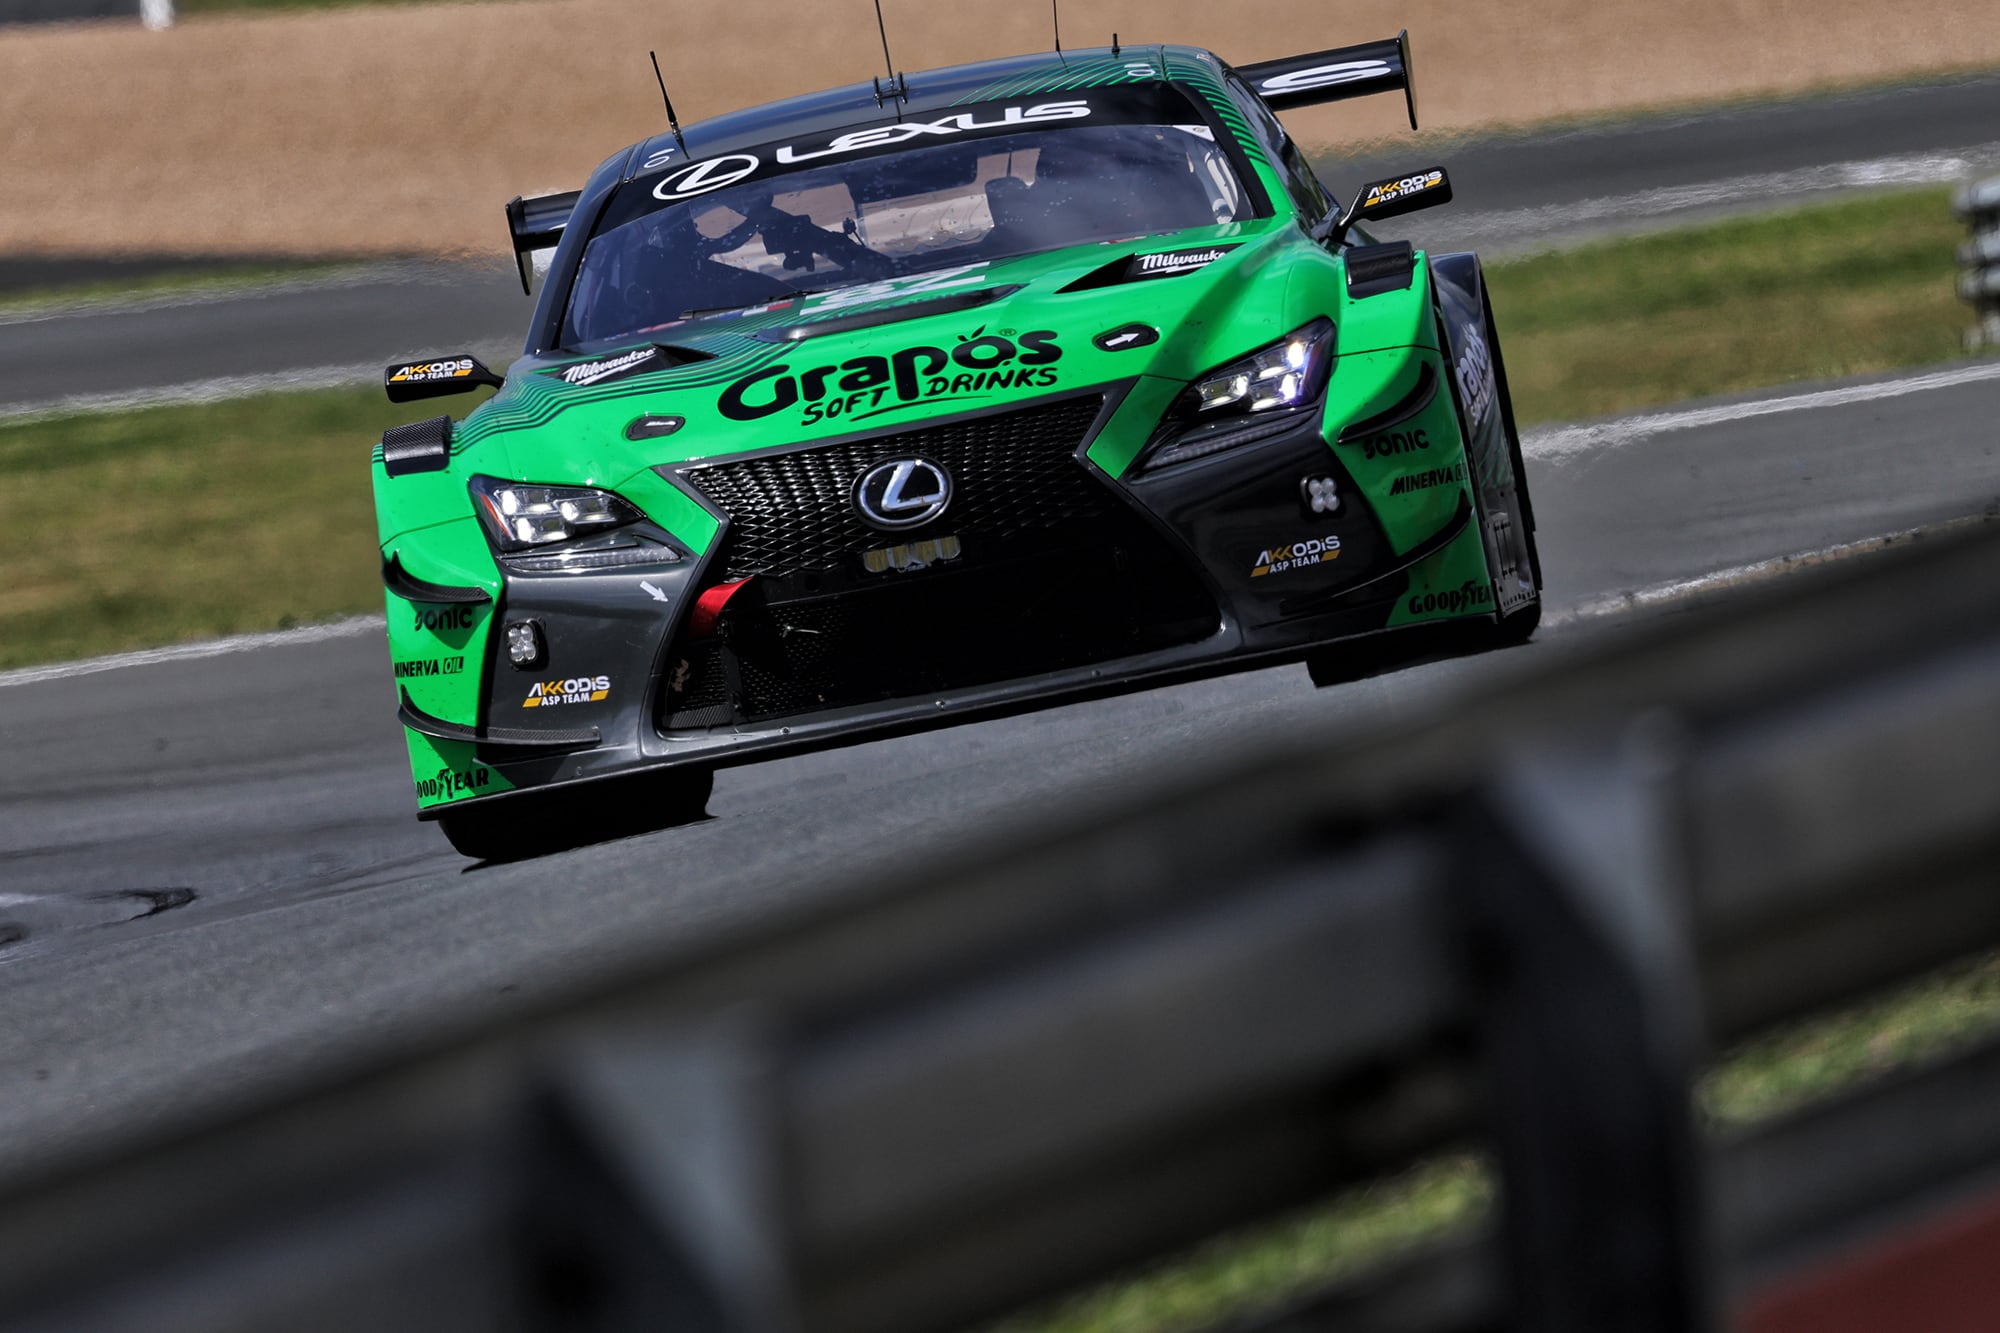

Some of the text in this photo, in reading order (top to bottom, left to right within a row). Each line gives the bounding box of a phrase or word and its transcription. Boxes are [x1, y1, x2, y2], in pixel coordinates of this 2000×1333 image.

[776, 100, 1091, 165] LEXUS
[1380, 183, 1424, 202] ASP TEAM
[427, 371, 453, 380] TEAM
[561, 347, 656, 383] Milwaukee
[801, 367, 1059, 426] SOFT DRINKS
[1390, 466, 1453, 496] MINERVA
[1269, 555, 1320, 574] ASP TEAM
[1408, 580, 1491, 615] GOODYEA
[443, 656, 463, 674] OIL
[541, 692, 590, 706] ASP TEAM
[416, 768, 489, 800] OODYEAR
